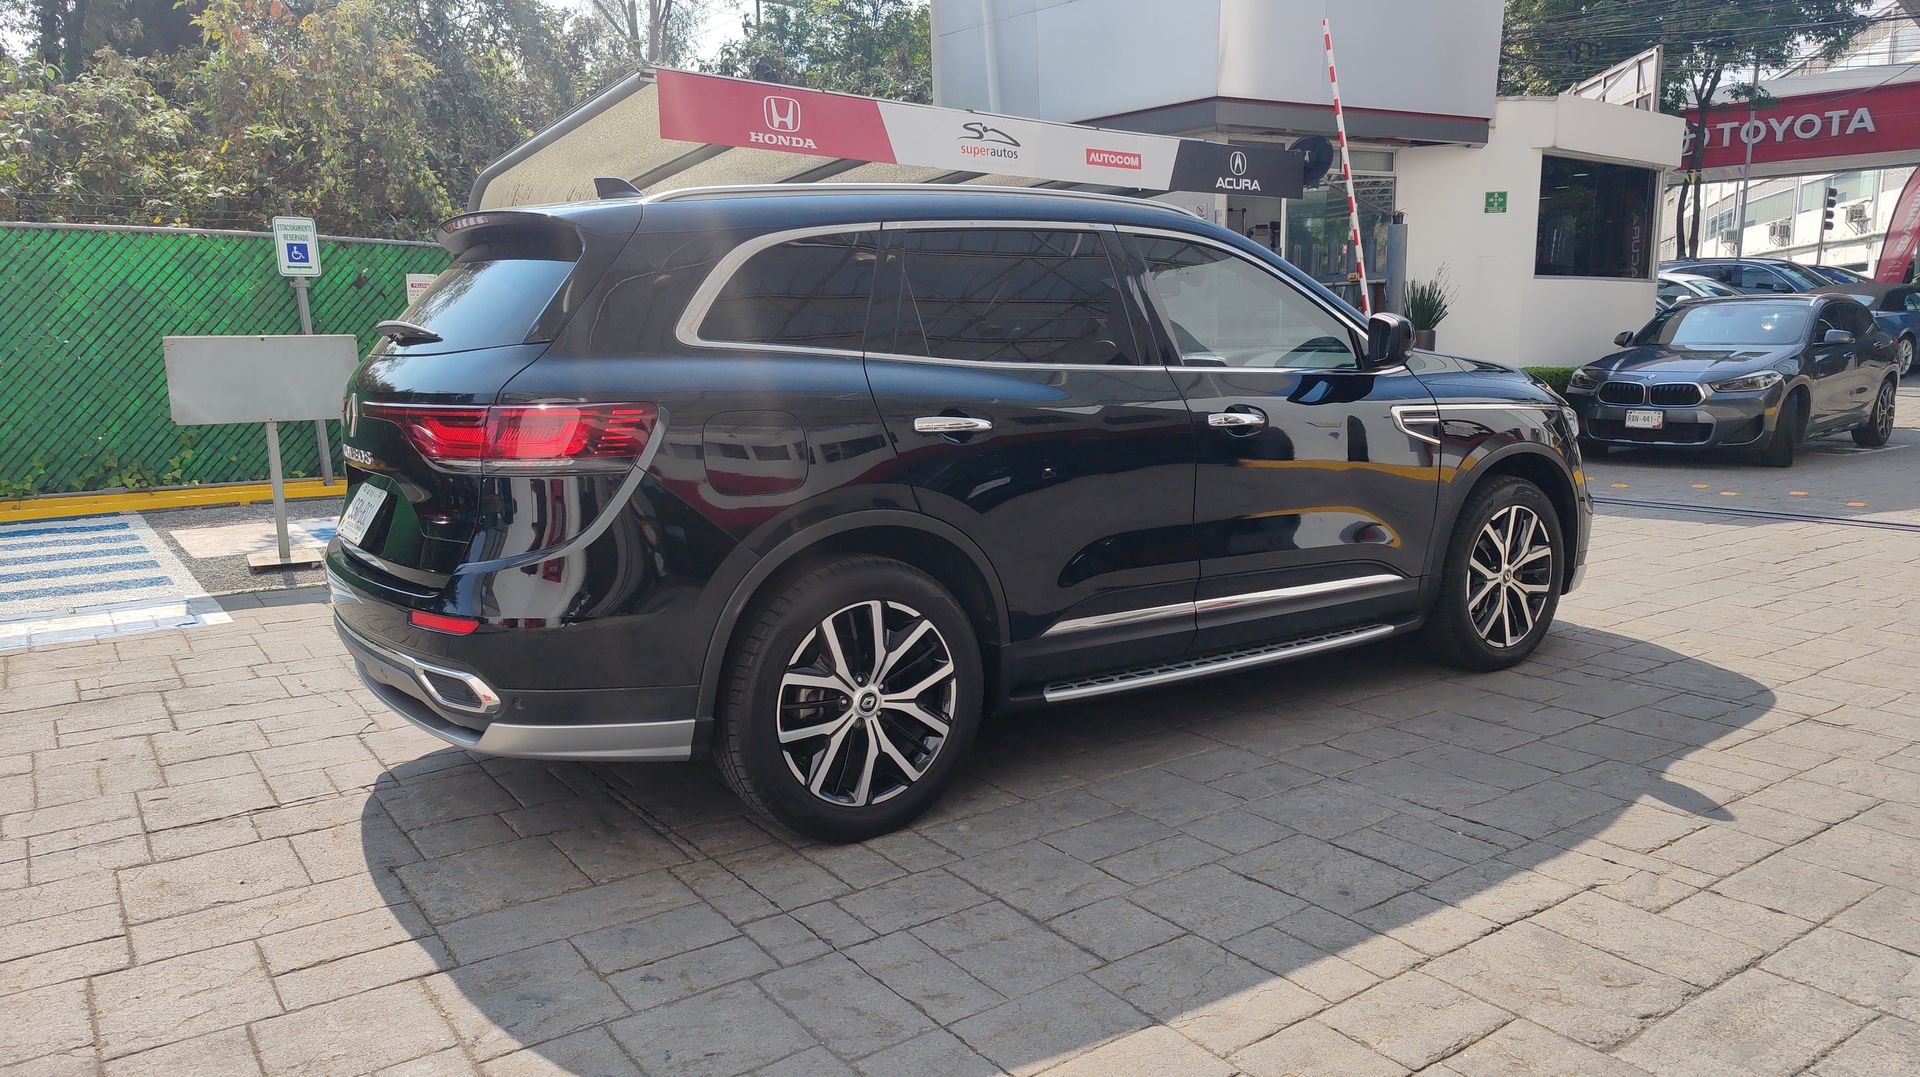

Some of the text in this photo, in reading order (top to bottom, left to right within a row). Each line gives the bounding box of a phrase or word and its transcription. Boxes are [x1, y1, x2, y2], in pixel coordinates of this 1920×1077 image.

[1716, 107, 1876, 147] TOYOTA
[749, 131, 818, 149] HONDA
[960, 145, 1018, 159] superautos
[1089, 152, 1139, 166] AUTOCOM
[1215, 176, 1261, 191] ACURA
[277, 224, 313, 232] ESTACIONAMIENTO
